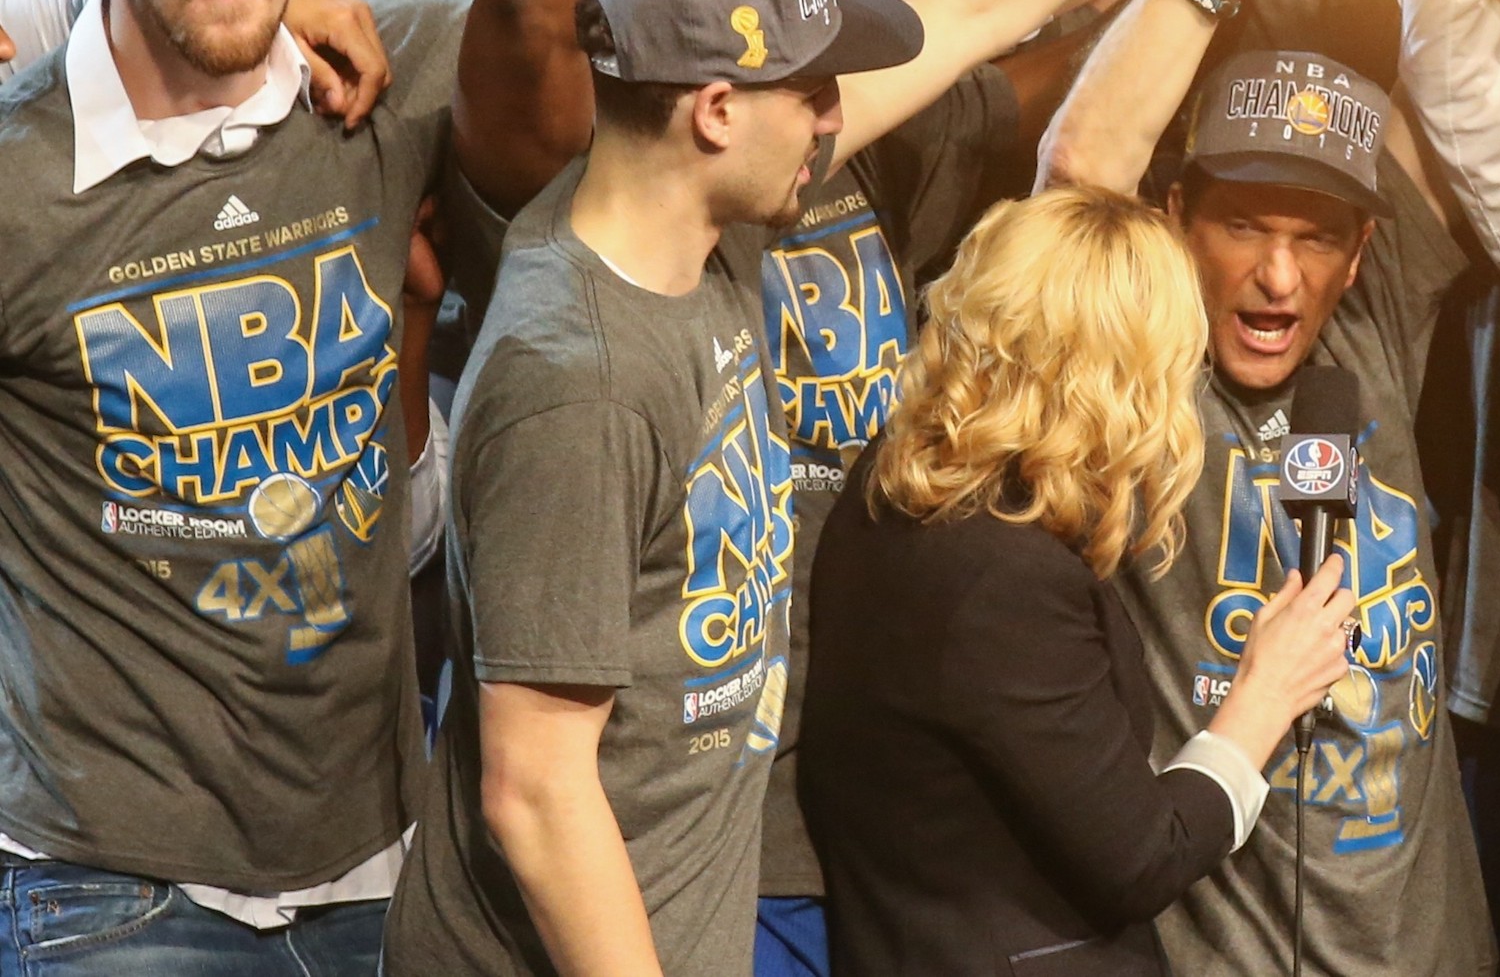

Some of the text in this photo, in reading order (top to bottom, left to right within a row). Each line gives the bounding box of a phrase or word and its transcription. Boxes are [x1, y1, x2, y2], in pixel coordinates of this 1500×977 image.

[1275, 59, 1351, 89] NBA
[213, 210, 260, 231] adidas
[108, 205, 350, 284] GOLDEN STATE WARRIORS
[74, 243, 394, 435] NBA
[1296, 469, 1332, 480] ESPN
[118, 505, 185, 527] LOCKER
[118, 521, 193, 539] AUTHENTIC
[1216, 447, 1419, 608] NA
[698, 677, 742, 708] LOCKER
[698, 692, 746, 719] AUTHENTIC
[687, 727, 732, 756] 2015
